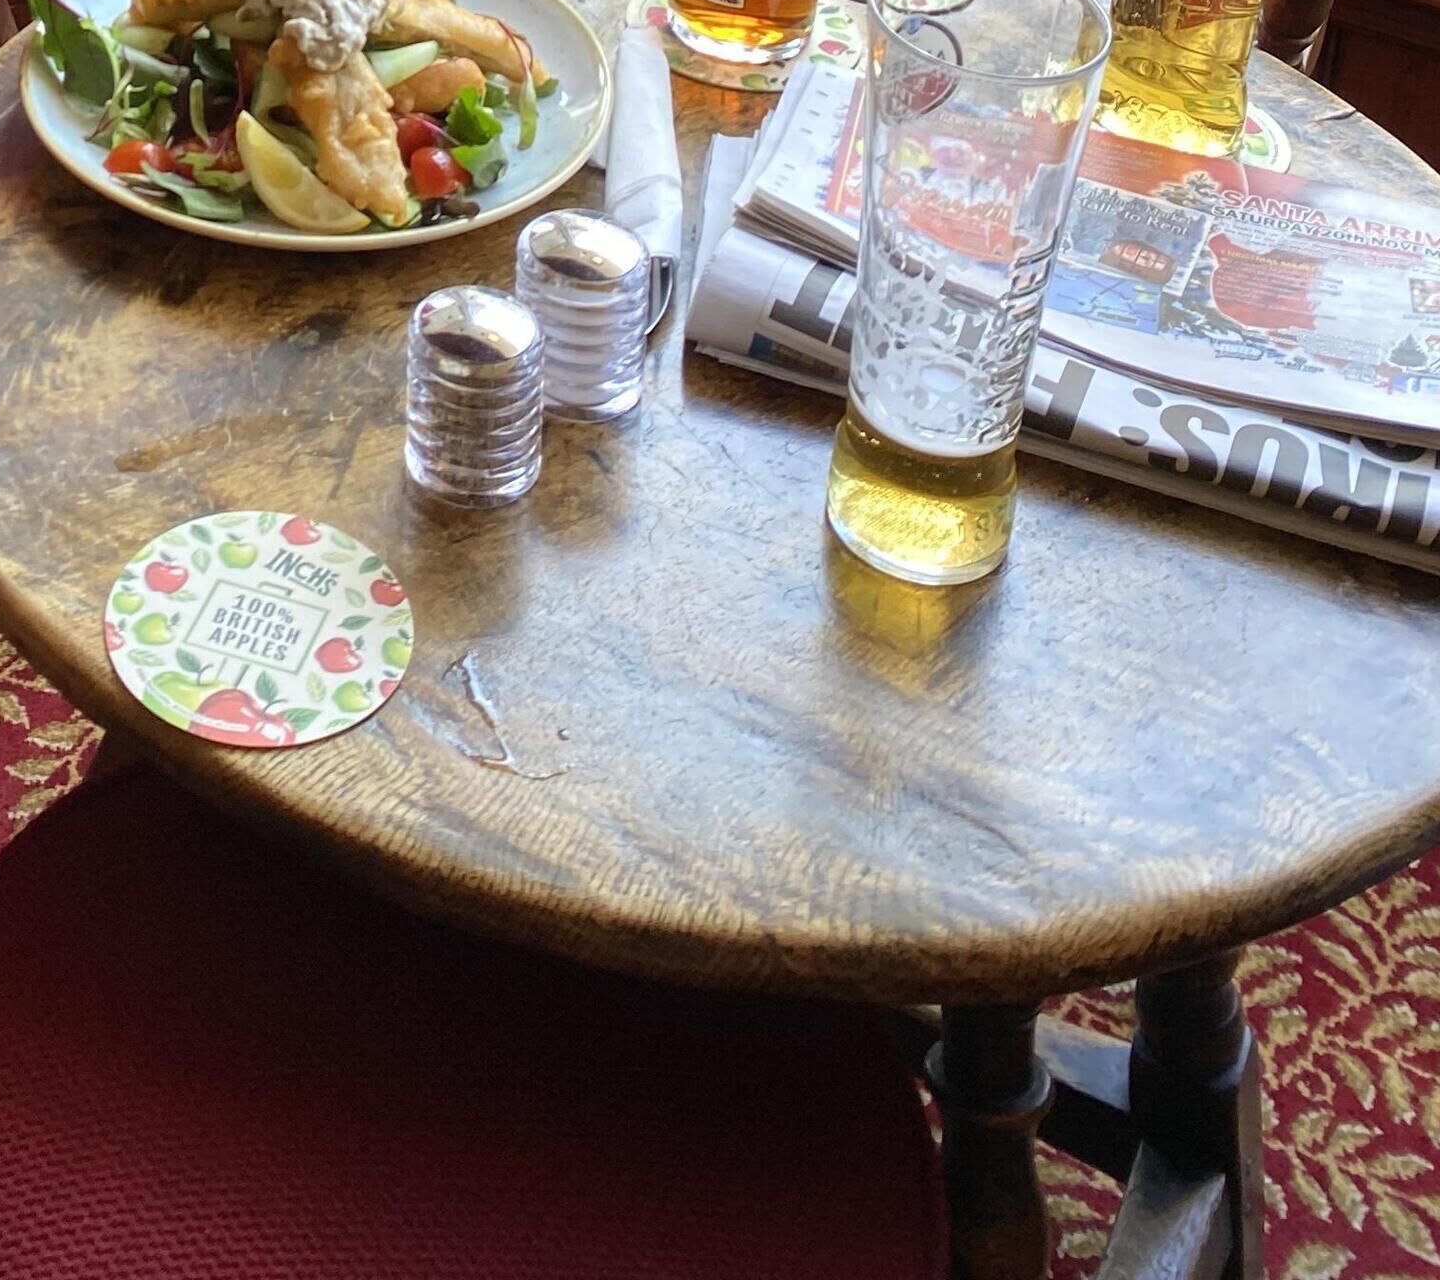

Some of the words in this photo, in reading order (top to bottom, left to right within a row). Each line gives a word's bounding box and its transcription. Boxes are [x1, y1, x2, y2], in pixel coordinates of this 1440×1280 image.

[1123, 210, 1142, 224] to
[1145, 214, 1190, 236] Rent
[1211, 205, 1315, 234] SATURDAY
[1320, 225, 1366, 244] 20th
[1222, 190, 1329, 227] SANTA
[1117, 387, 1440, 543] IRUS:
[212, 609, 303, 646] BRITISH
[232, 593, 295, 625] 100%
[208, 626, 290, 663] APPLES
